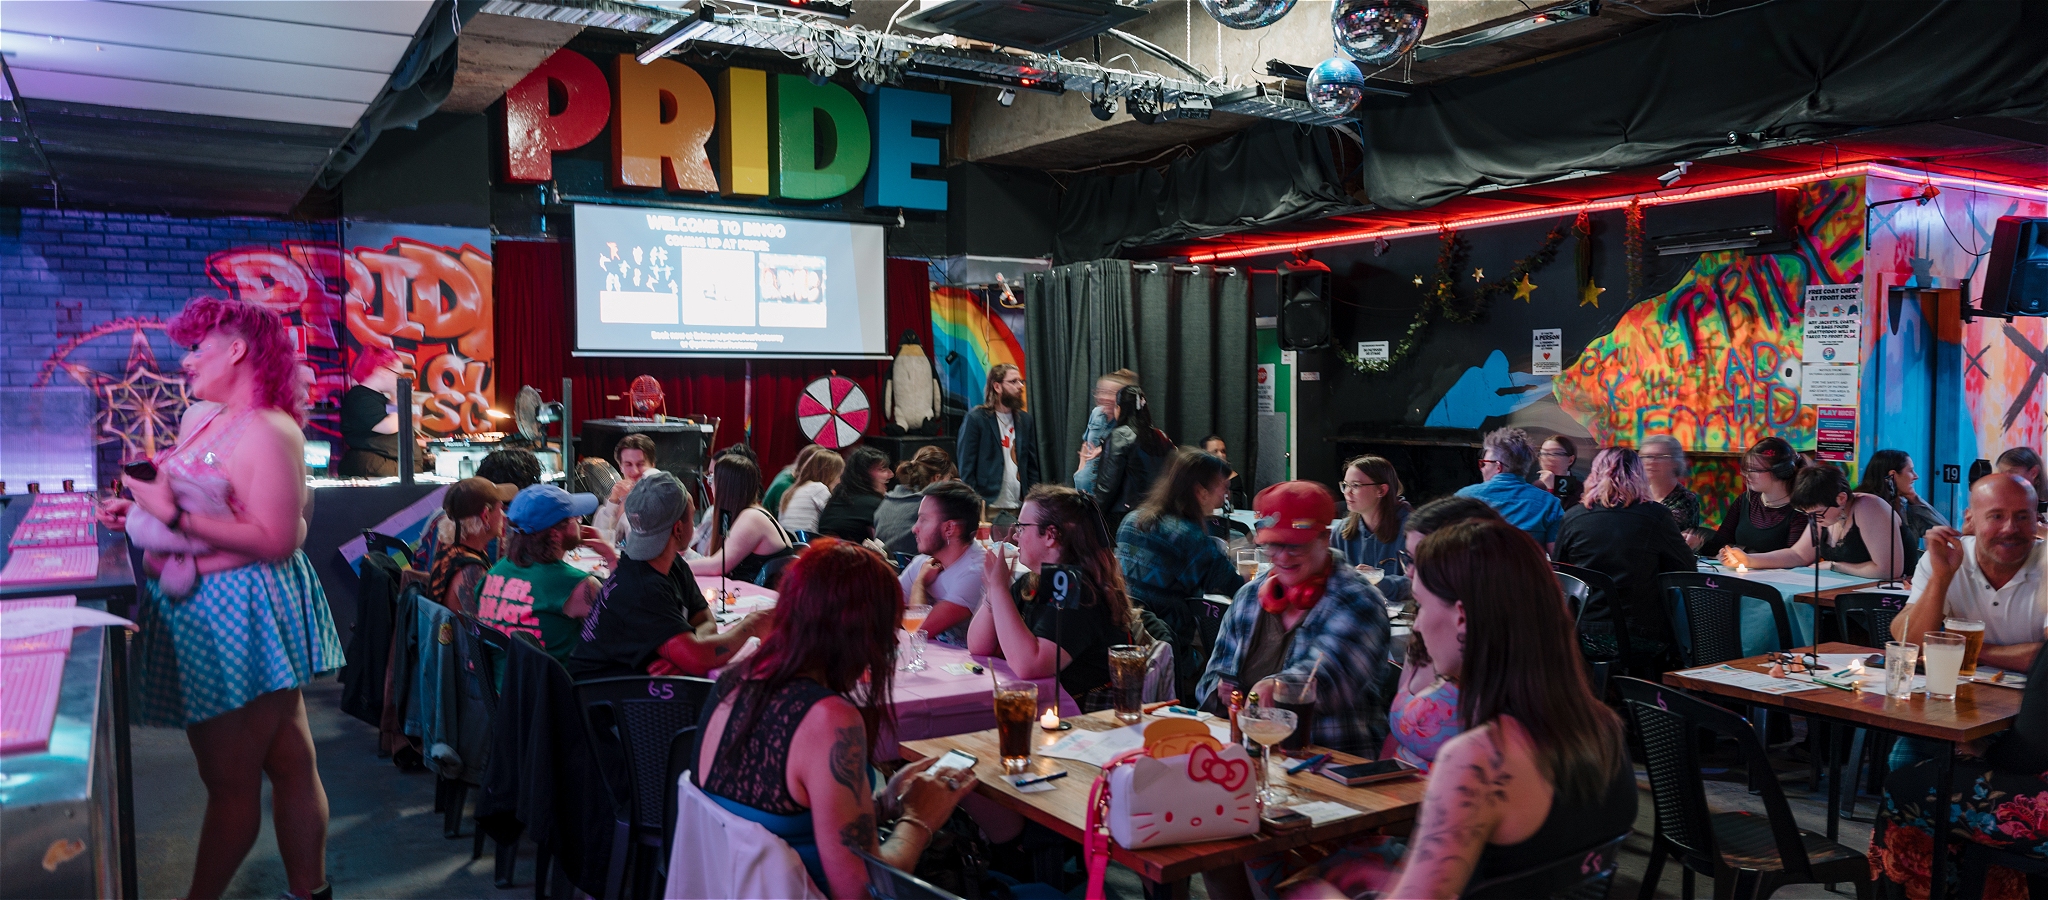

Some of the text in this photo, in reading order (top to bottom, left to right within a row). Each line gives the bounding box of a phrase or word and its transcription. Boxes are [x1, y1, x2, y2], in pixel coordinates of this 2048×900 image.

[504, 49, 952, 211] PRIDE
[646, 214, 787, 239] WELCOME TO BINGO
[664, 234, 707, 248] COMING
[706, 237, 722, 249] UP
[722, 238, 737, 250] AT
[1945, 467, 1958, 480] 19
[1559, 479, 1567, 492] 2
[1053, 570, 1068, 601] 9
[1705, 577, 1719, 588] 4
[648, 680, 674, 700] 65
